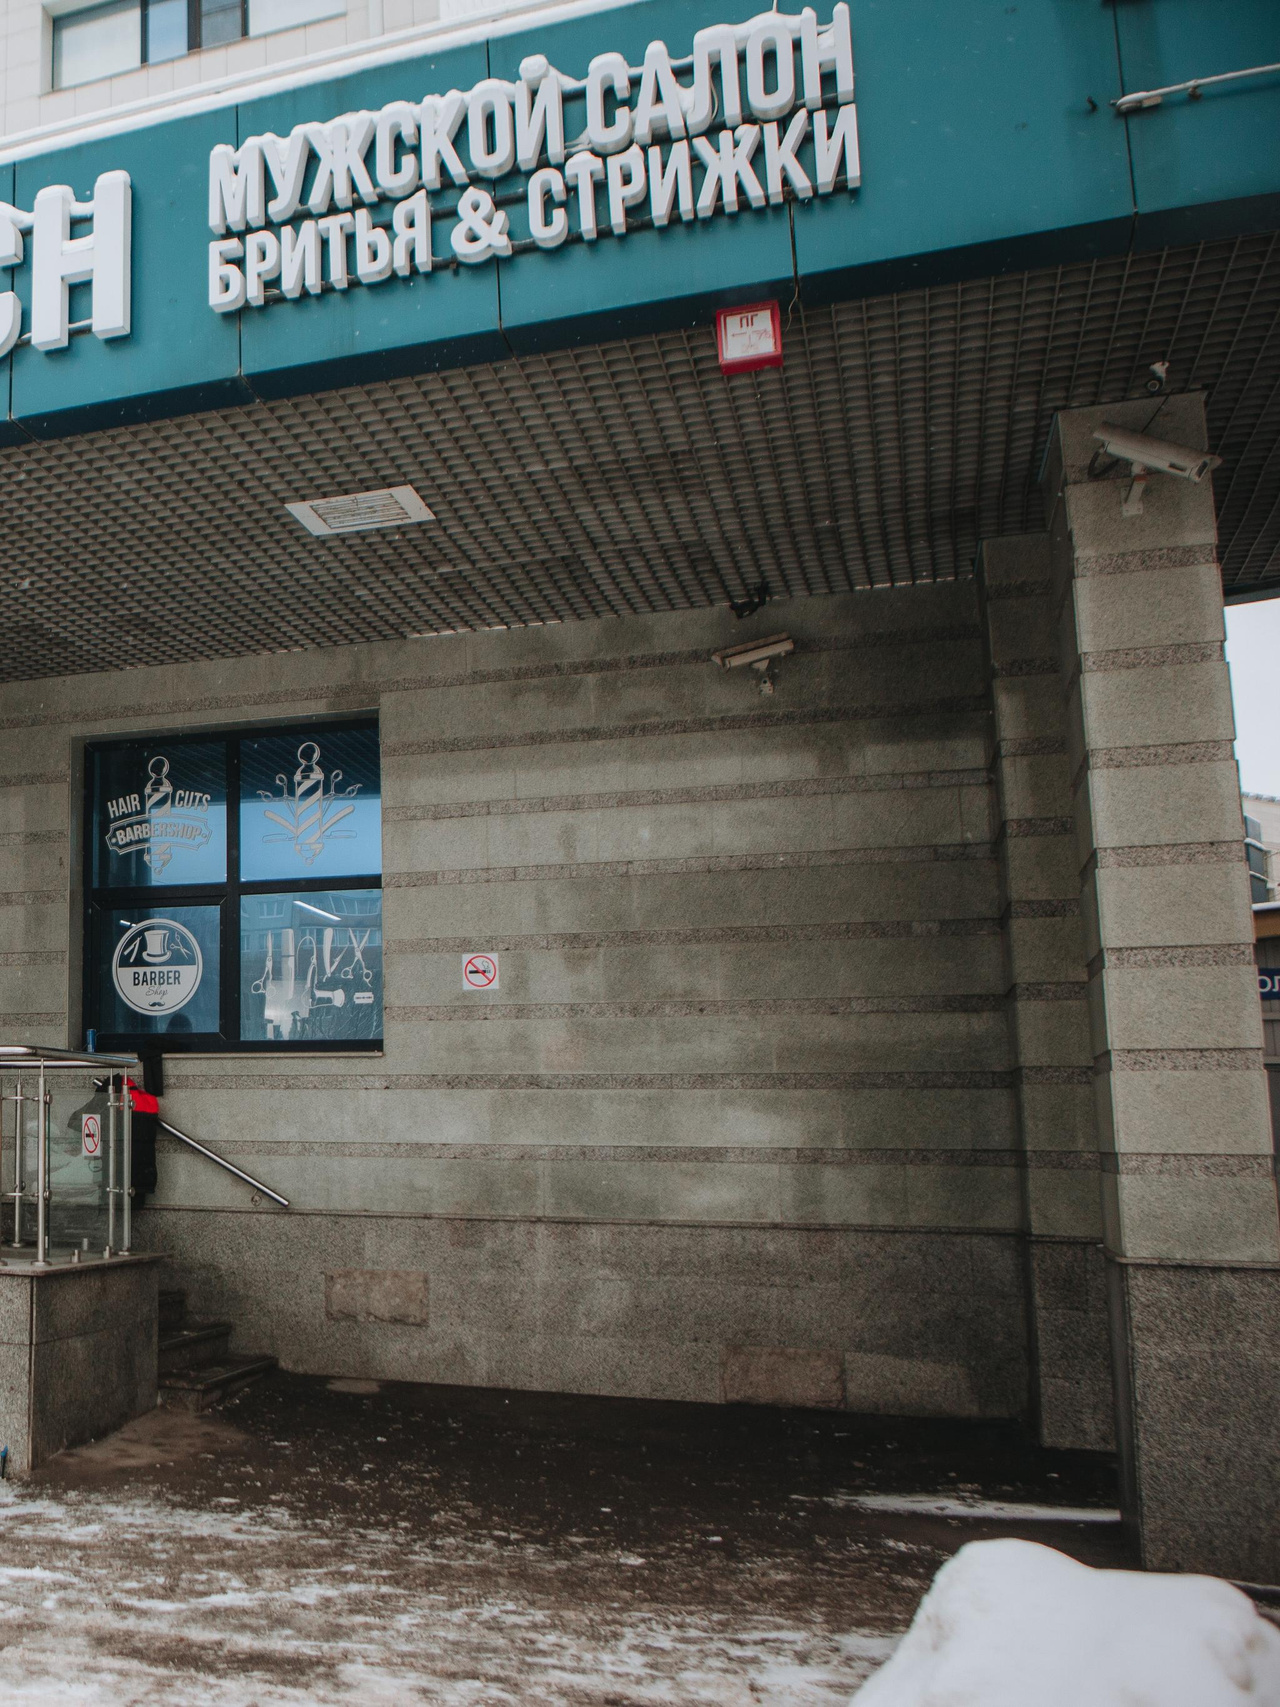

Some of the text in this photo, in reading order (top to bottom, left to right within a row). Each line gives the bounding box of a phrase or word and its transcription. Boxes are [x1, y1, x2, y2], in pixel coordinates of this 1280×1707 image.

[209, 1, 856, 234] МУЖСКОЙ САЛОН
[208, 102, 861, 312] БРИТЬЯ & СТРИЖКИ
[107, 790, 211, 819] HAIR CUTS
[116, 822, 202, 845] BARBERSHOP
[133, 970, 181, 986] BARBER
